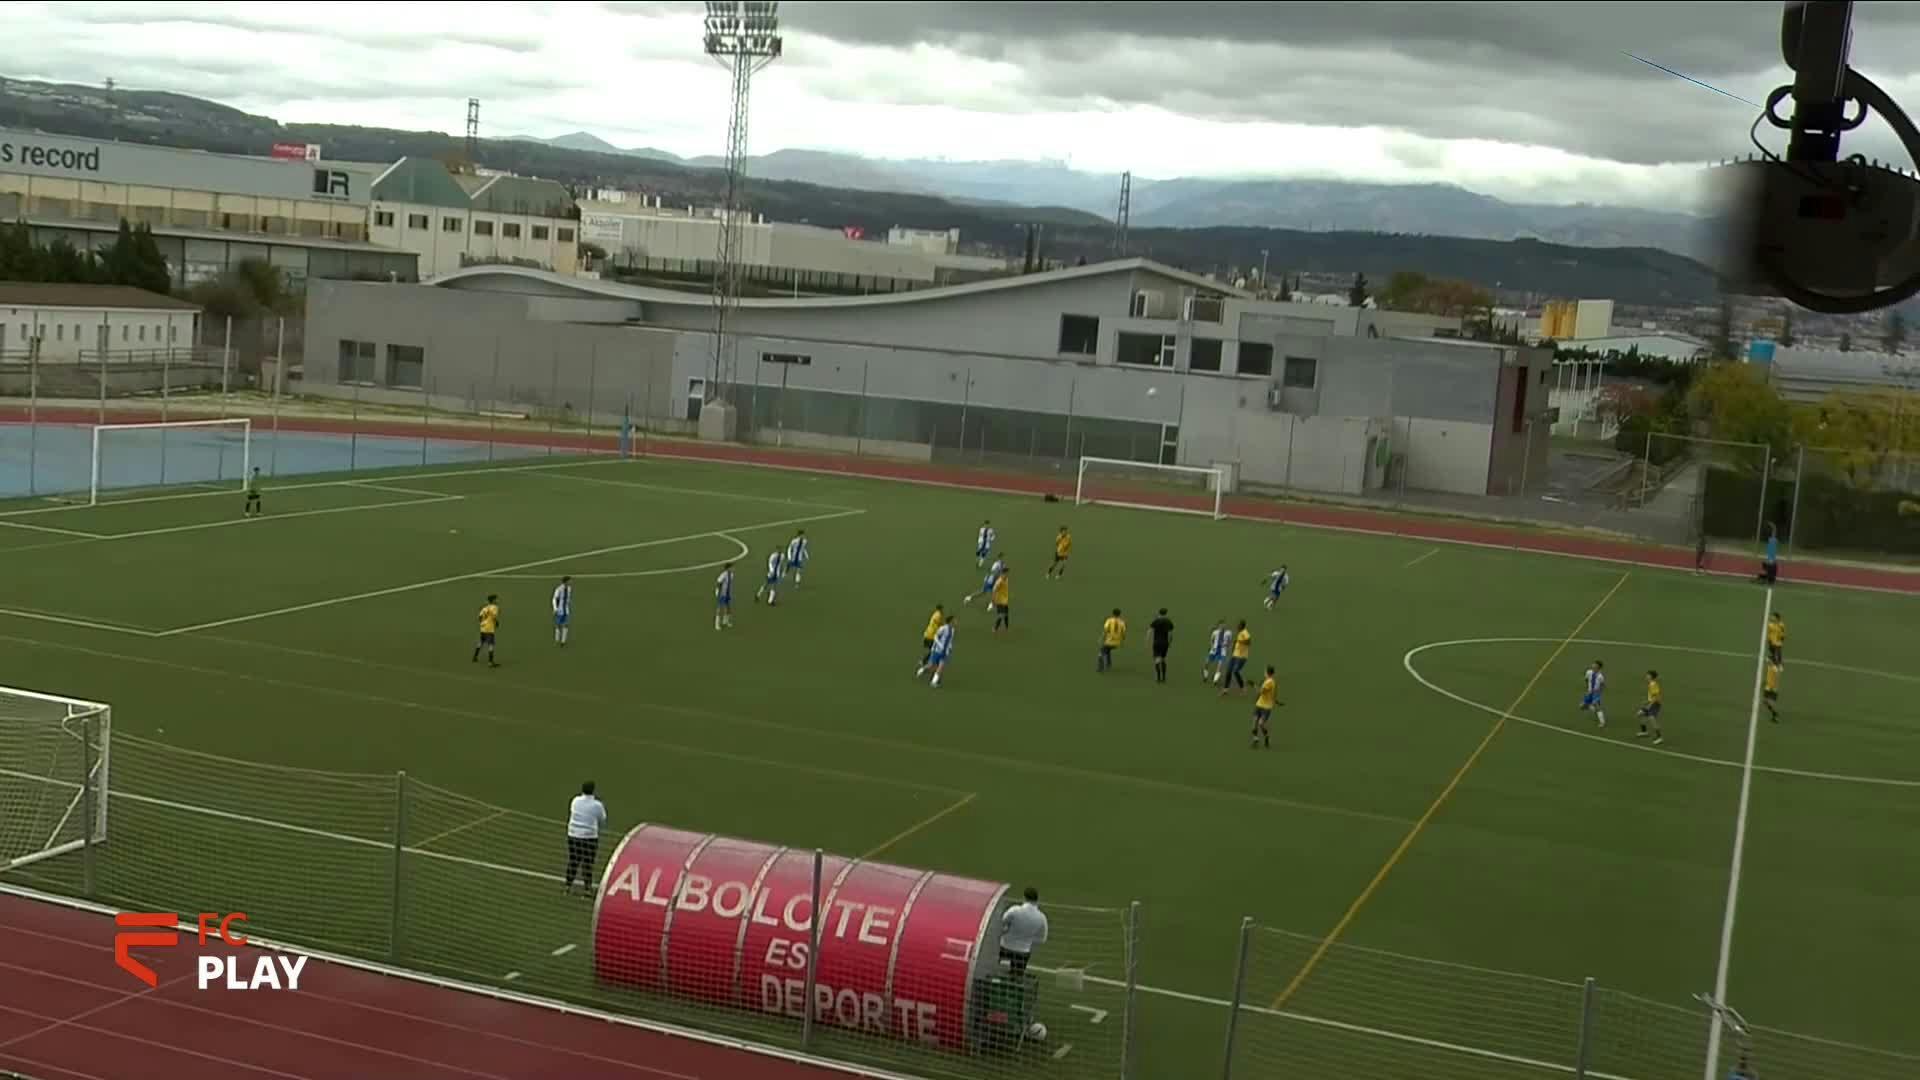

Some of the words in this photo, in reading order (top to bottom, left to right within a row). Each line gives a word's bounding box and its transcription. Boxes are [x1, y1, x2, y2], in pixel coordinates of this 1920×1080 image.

[21, 145, 99, 171] record
[607, 863, 896, 945] ALBOLOTE
[765, 937, 809, 969] ES
[761, 974, 938, 1046] DEPORTE
